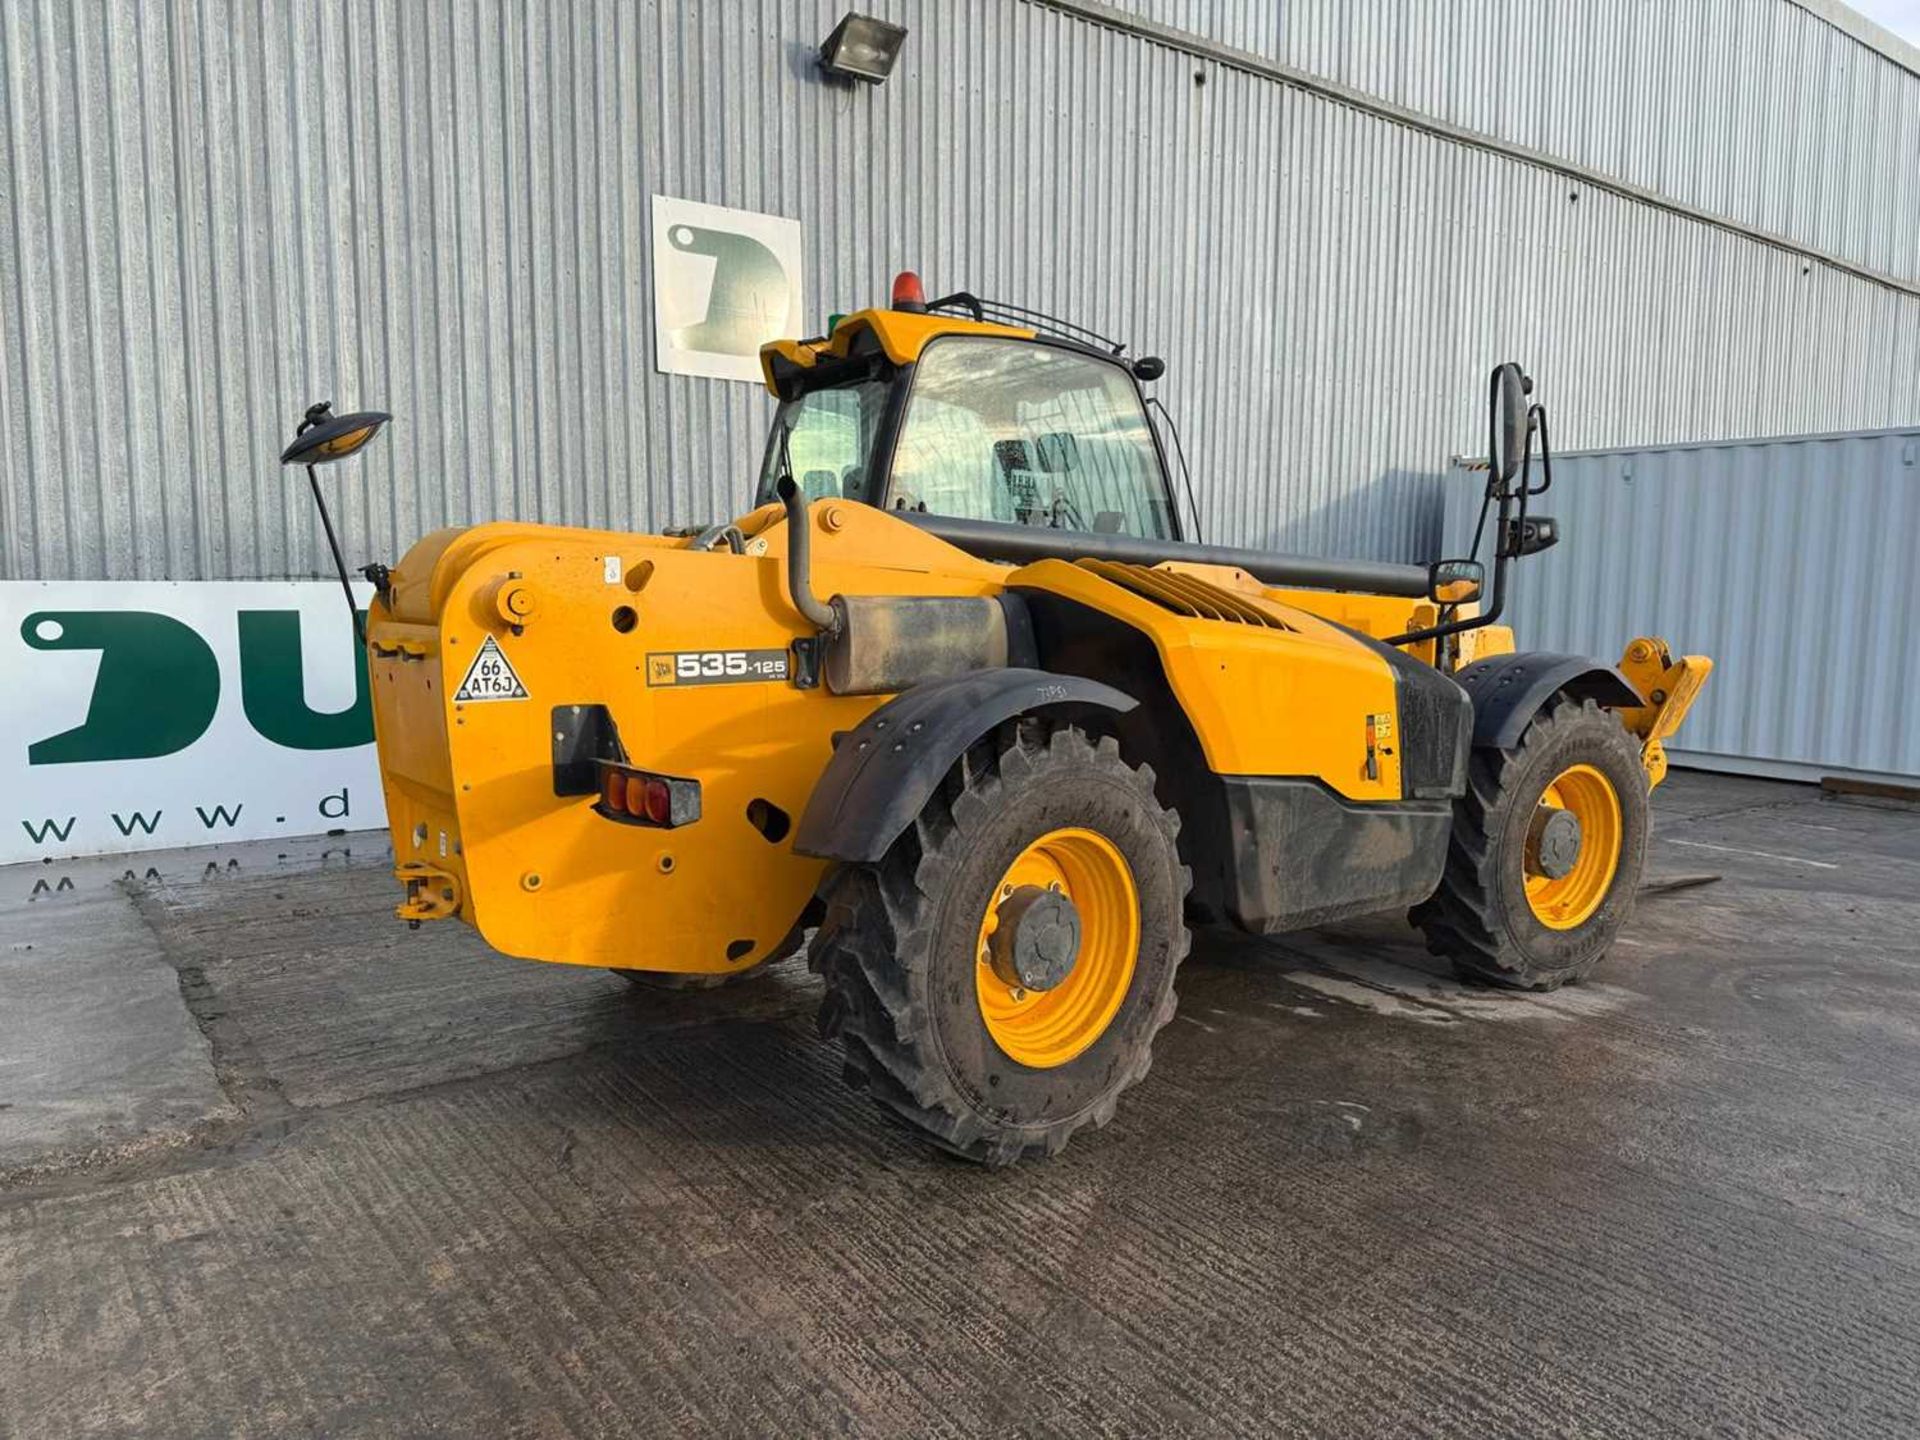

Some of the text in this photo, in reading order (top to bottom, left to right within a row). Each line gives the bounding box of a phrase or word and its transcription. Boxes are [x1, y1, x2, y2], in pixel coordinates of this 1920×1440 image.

[481, 660, 501, 676] 66
[677, 652, 786, 677] 535-125
[472, 677, 512, 693] AT6J
